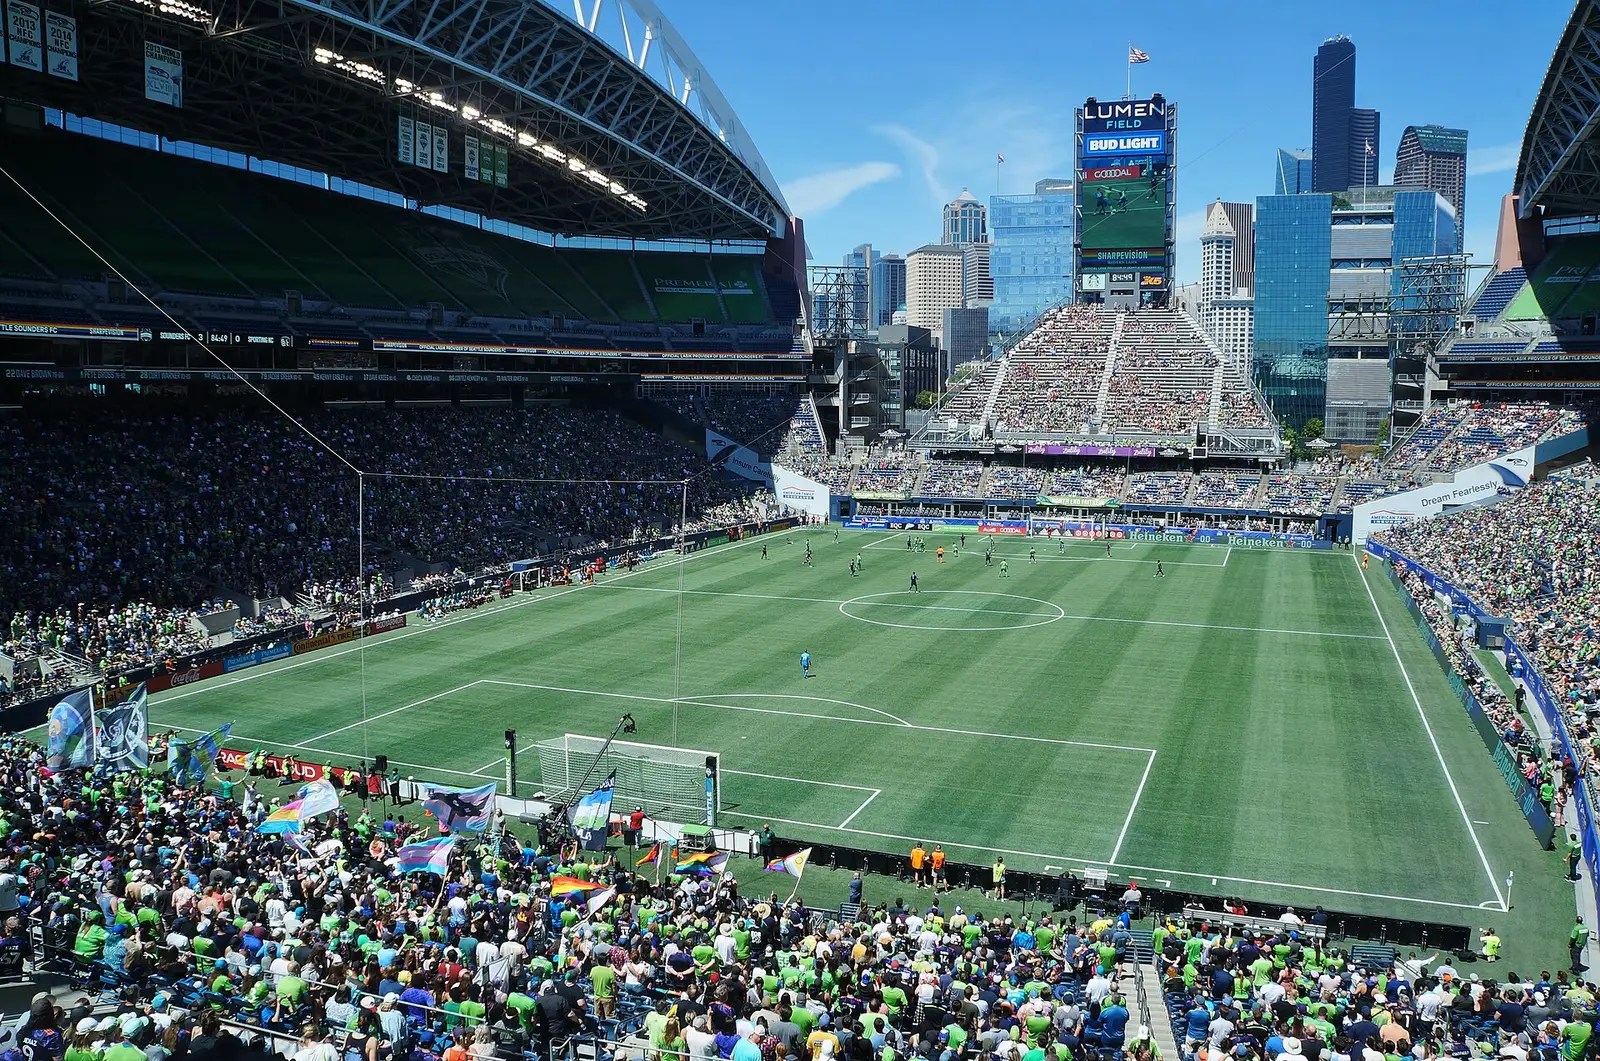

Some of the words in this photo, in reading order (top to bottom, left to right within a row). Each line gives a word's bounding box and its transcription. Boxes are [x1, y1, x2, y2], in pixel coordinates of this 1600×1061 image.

[13, 16, 35, 31] 2013
[17, 27, 33, 39] NFC
[51, 27, 72, 41] 2014
[9, 34, 41, 48] CHAMPIONS
[55, 39, 69, 49] NFC
[47, 45, 76, 58] CHAMPIONS
[146, 43, 160, 53] 2013
[161, 47, 180, 59] WORLD
[146, 51, 180, 66] CHAMPIONS
[1085, 103, 1164, 119] LUMEN
[1106, 119, 1142, 129] FIELD
[1089, 139, 1118, 151] BUD
[1097, 250, 1148, 260] SHARPEVISION
[655, 278, 727, 288] PREMERA
[1112, 273, 1133, 282] 84:49
[14, 325, 49, 334] SOUNDERS
[89, 327, 124, 336] SHARPEVISION
[160, 332, 185, 340] SOUNDERS
[198, 333, 204, 341] 3
[211, 334, 228, 342] 84:49
[235, 335, 240, 343] 0
[5, 369, 16, 378] 22
[16, 369, 31, 378] DAVE
[32, 370, 52, 378] BROWN
[732, 457, 752, 470] Insure
[752, 465, 780, 484] Carefully
[1421, 493, 1451, 508] Dream
[1452, 479, 1498, 499] Fearlessly
[1130, 531, 1183, 542] Heineken
[1228, 536, 1284, 548] Heineken
[294, 636, 332, 653] Continental
[337, 632, 351, 640] TIRE
[1493, 740, 1520, 795] Heineken
[22, 1044, 34, 1061] 9
